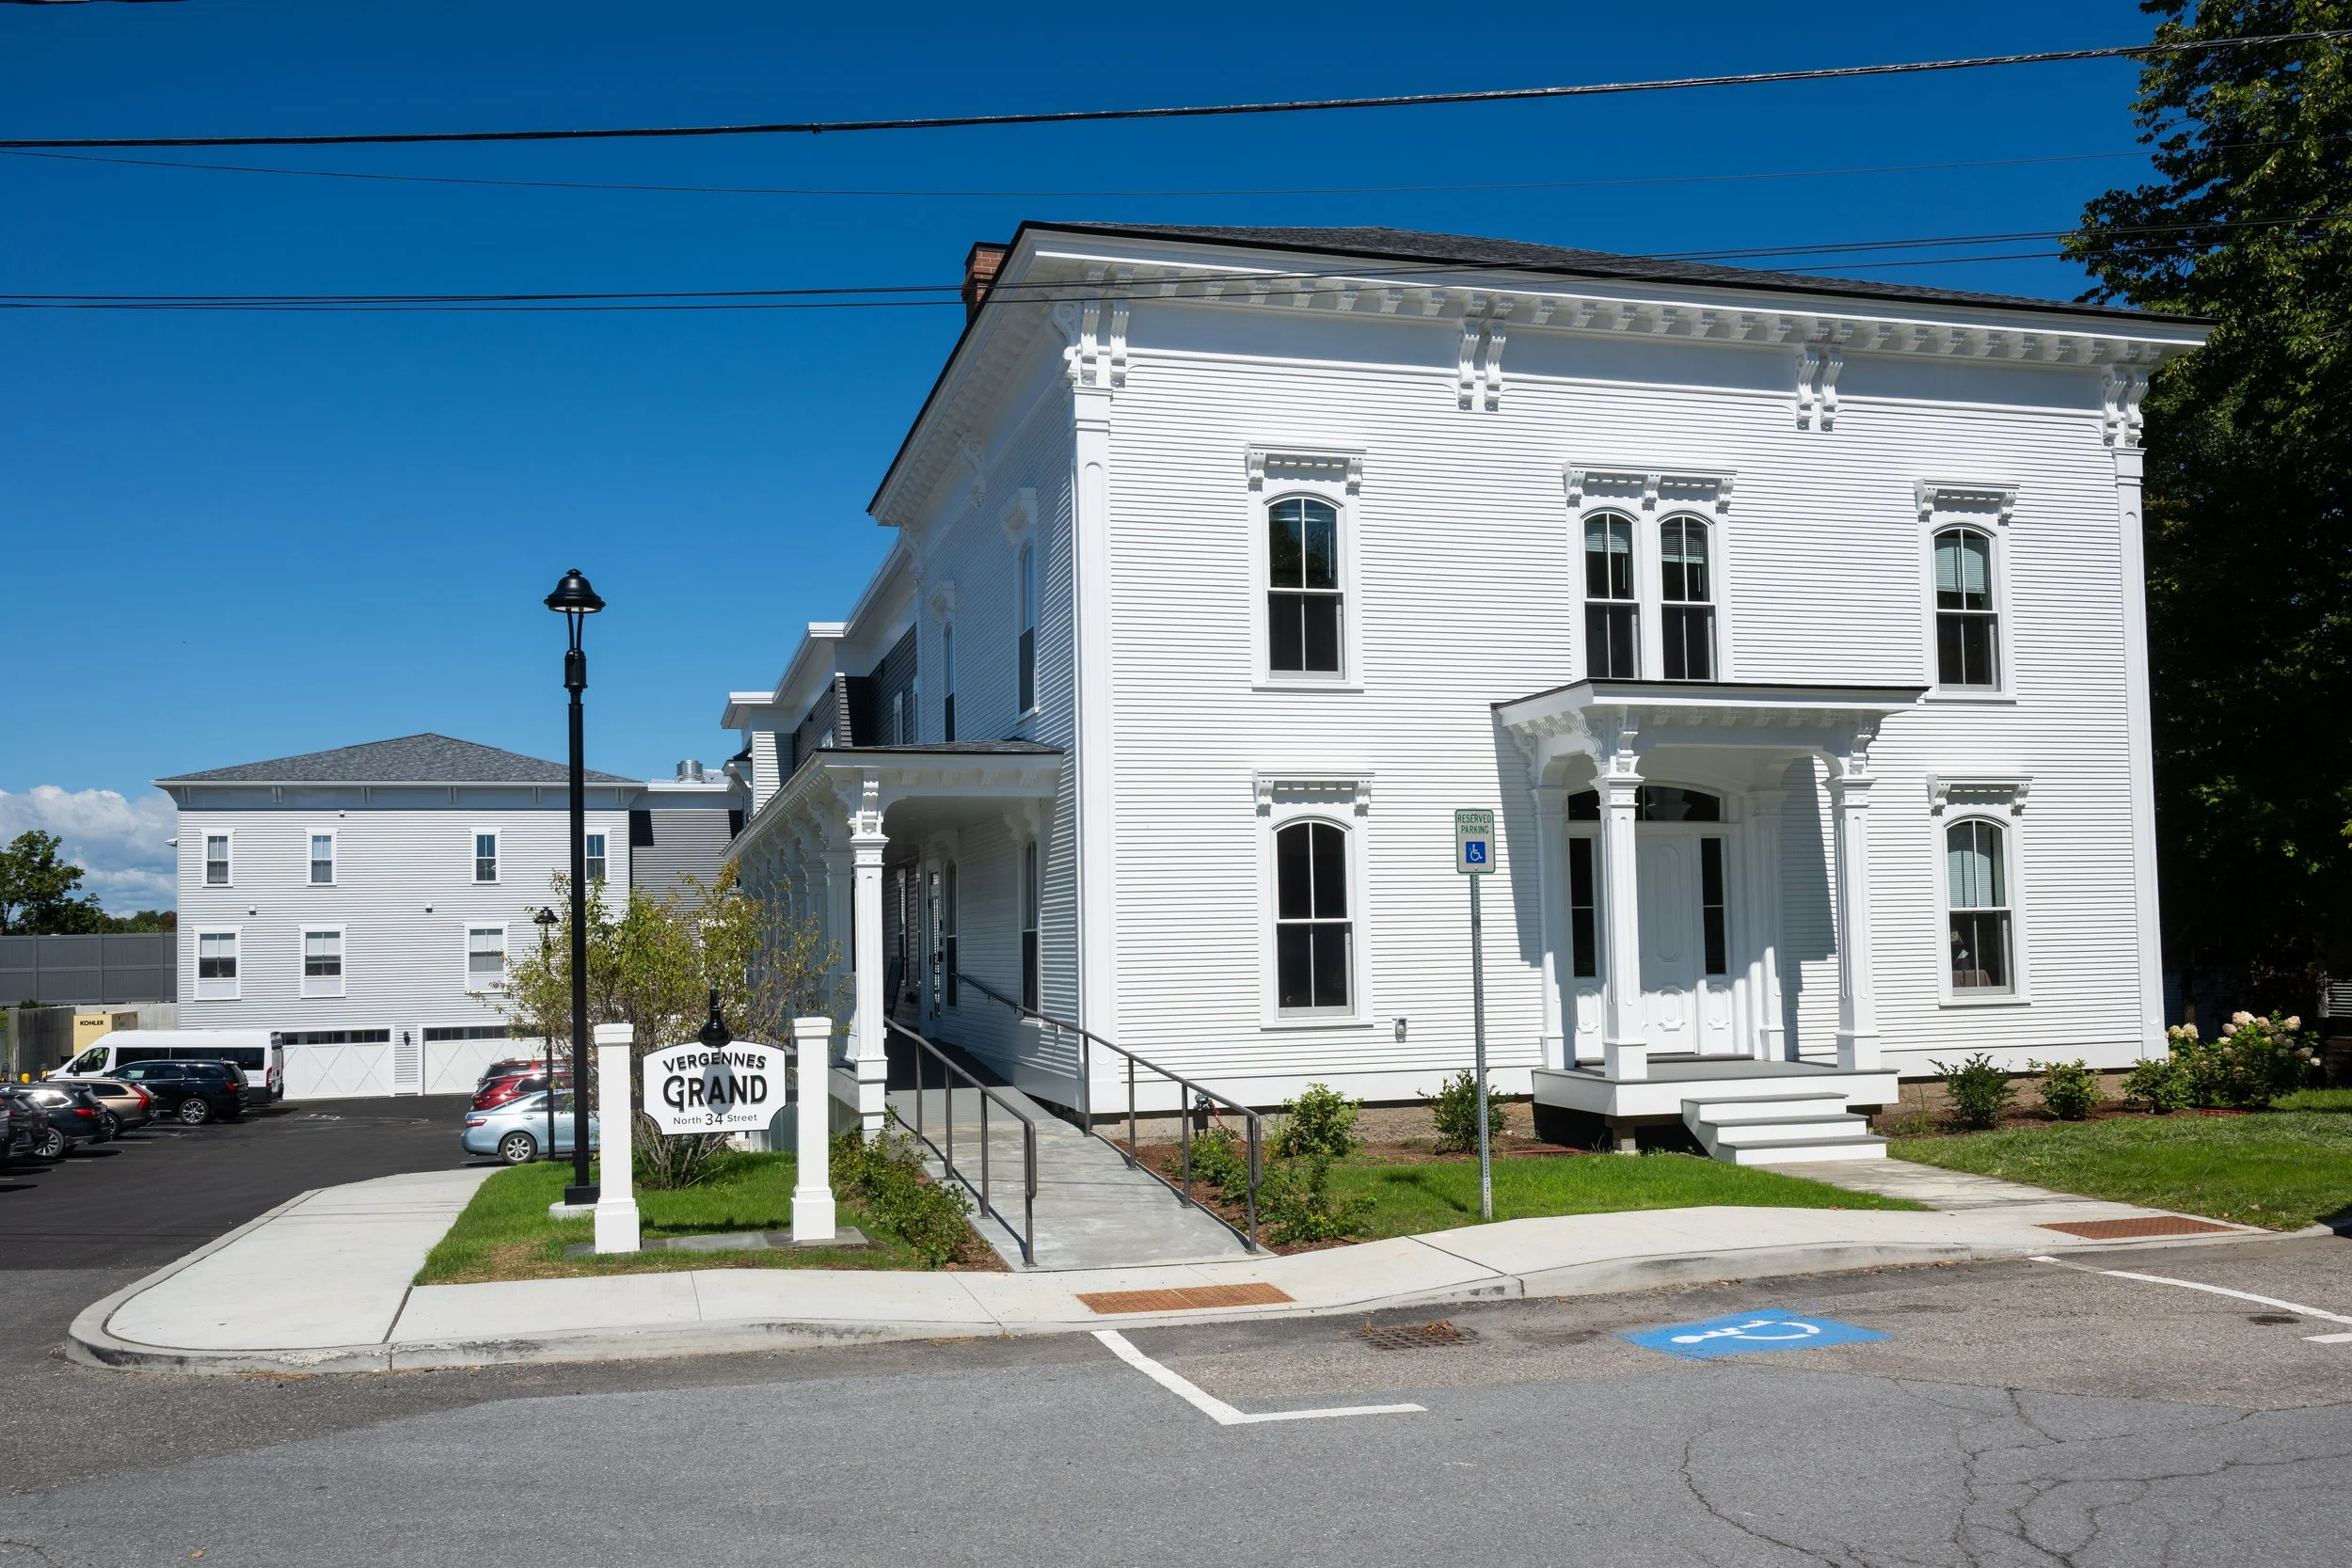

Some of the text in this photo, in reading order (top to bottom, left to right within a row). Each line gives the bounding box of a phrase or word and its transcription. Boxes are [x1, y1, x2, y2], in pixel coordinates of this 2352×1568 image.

[1457, 815, 1491, 823] RESERVED
[1461, 825, 1488, 834] PARKING
[662, 1052, 767, 1073] VERGENNES
[662, 1074, 768, 1113] GRAND
[673, 1113, 757, 1126] North 34 Street
